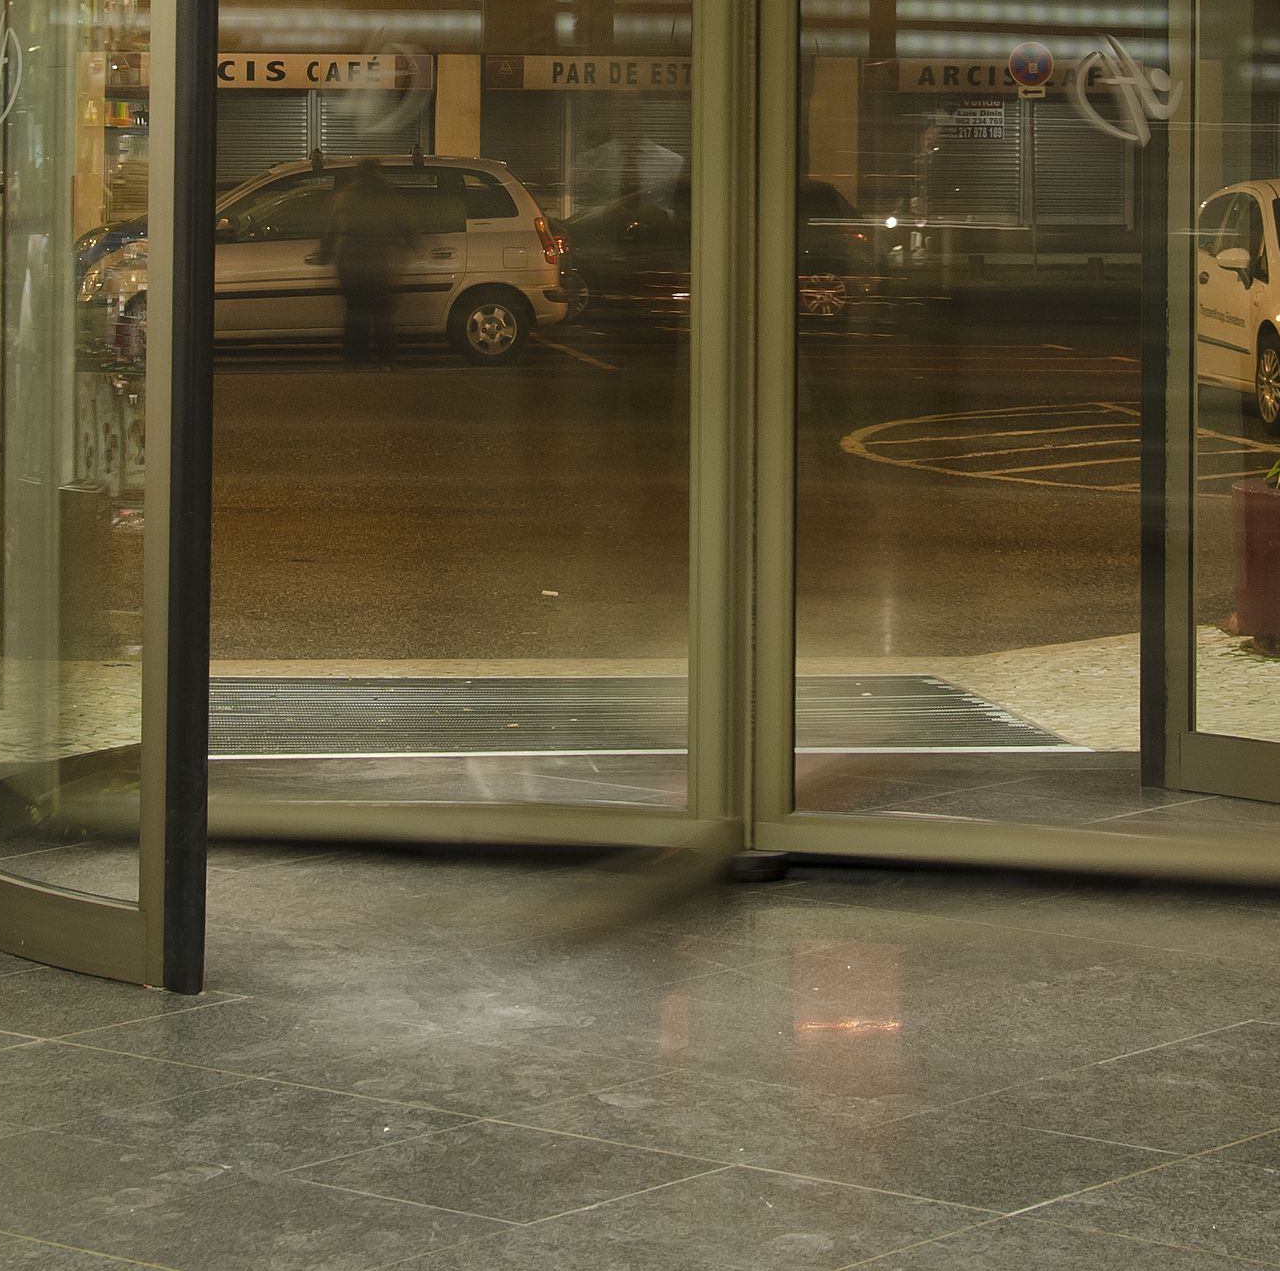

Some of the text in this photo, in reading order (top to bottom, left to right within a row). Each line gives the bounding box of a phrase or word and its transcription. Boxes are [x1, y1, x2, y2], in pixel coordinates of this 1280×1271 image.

[306, 55, 381, 82] CAFÉ
[552, 61, 596, 84] PAR
[609, 62, 638, 85] DE
